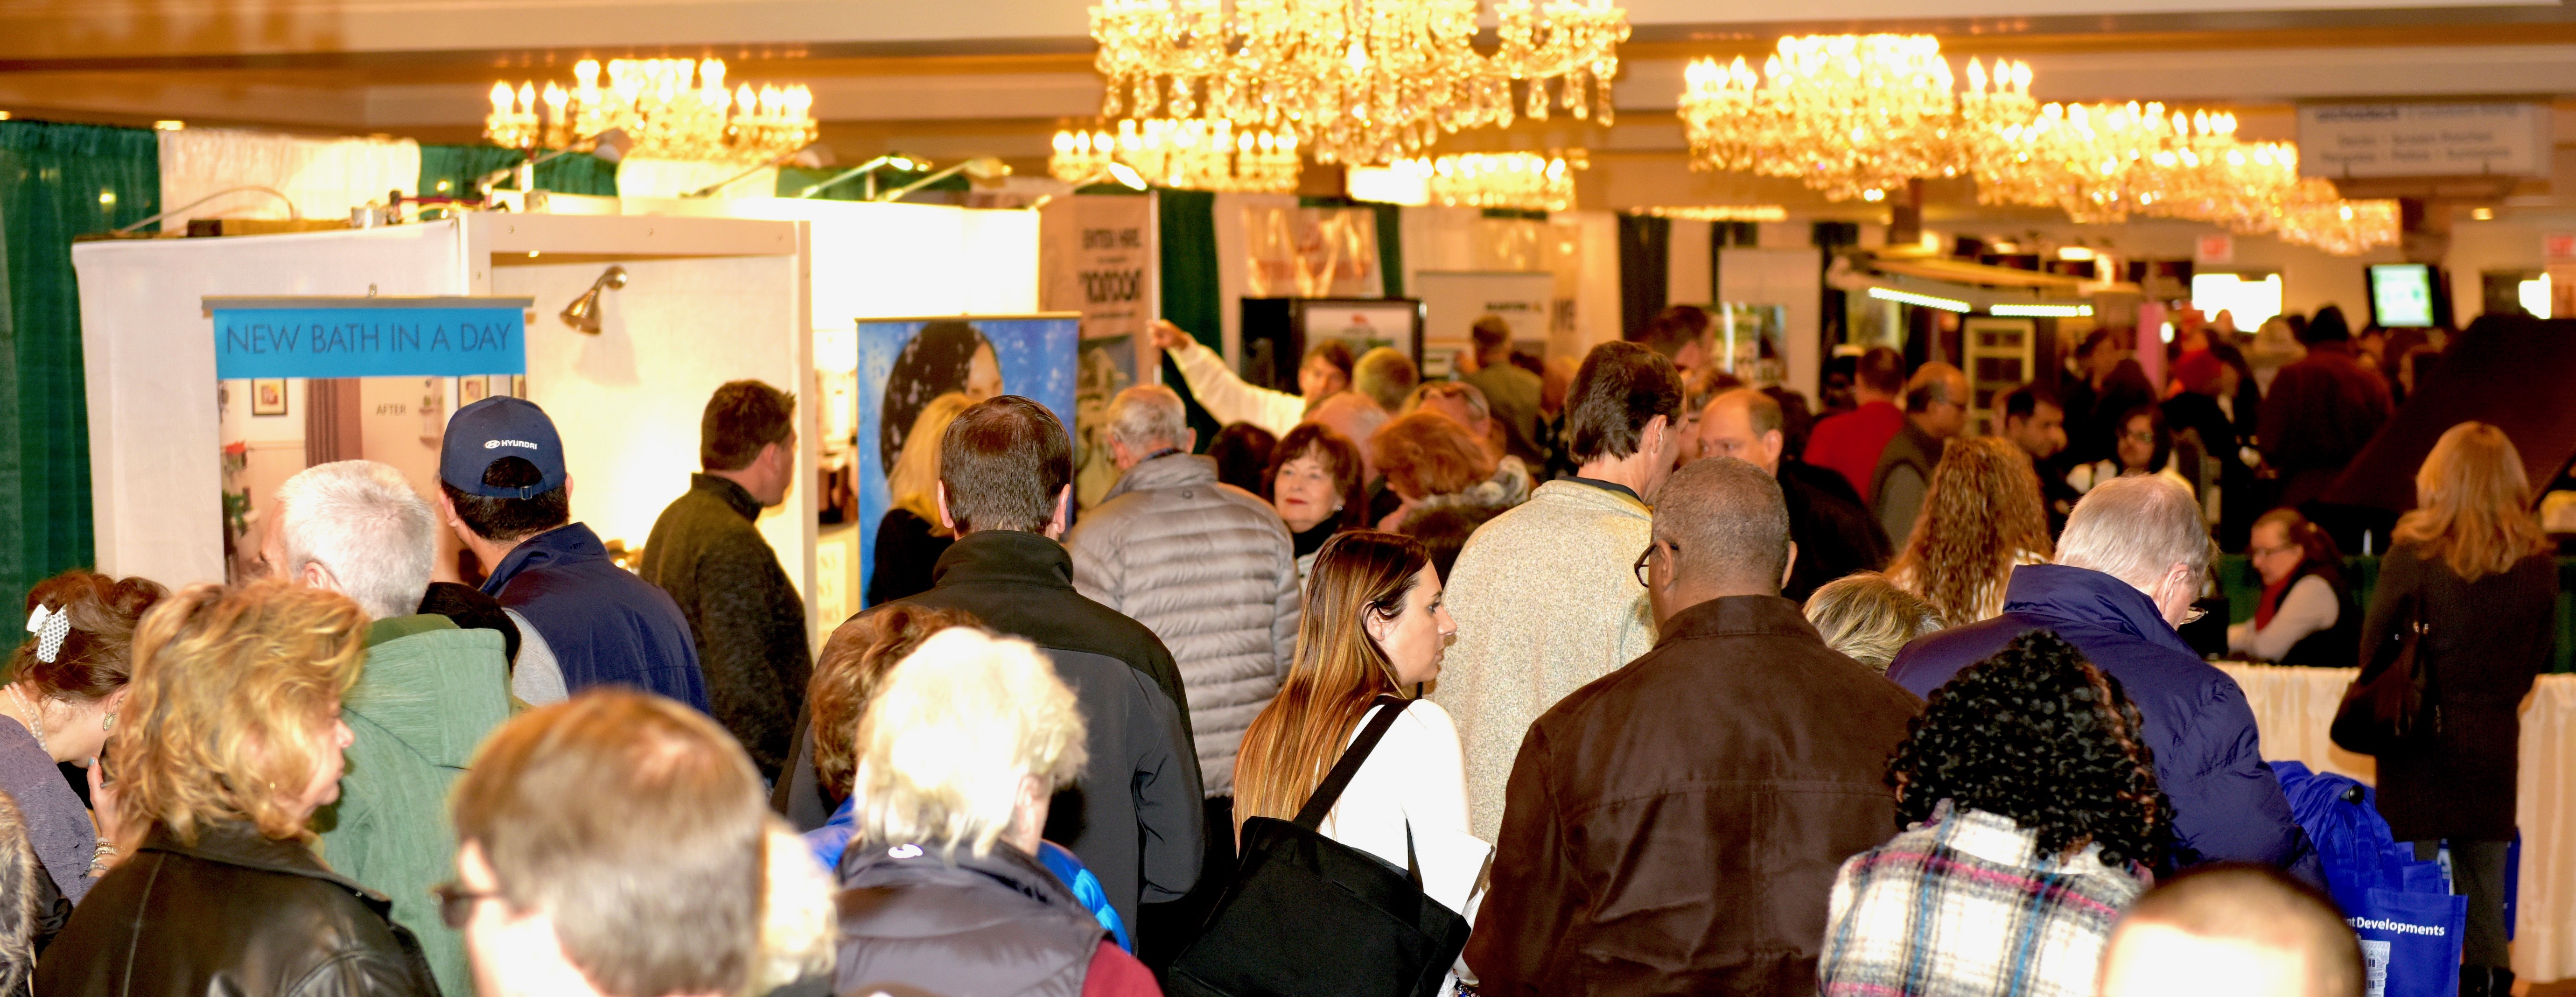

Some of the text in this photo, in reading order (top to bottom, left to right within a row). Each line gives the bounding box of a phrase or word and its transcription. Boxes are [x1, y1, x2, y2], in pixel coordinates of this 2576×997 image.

[227, 323, 511, 353] NEW BATH IN A DAY
[376, 403, 406, 415] AFTER
[501, 440, 537, 449] HYUNDAI
[2357, 916, 2445, 936] Developments
